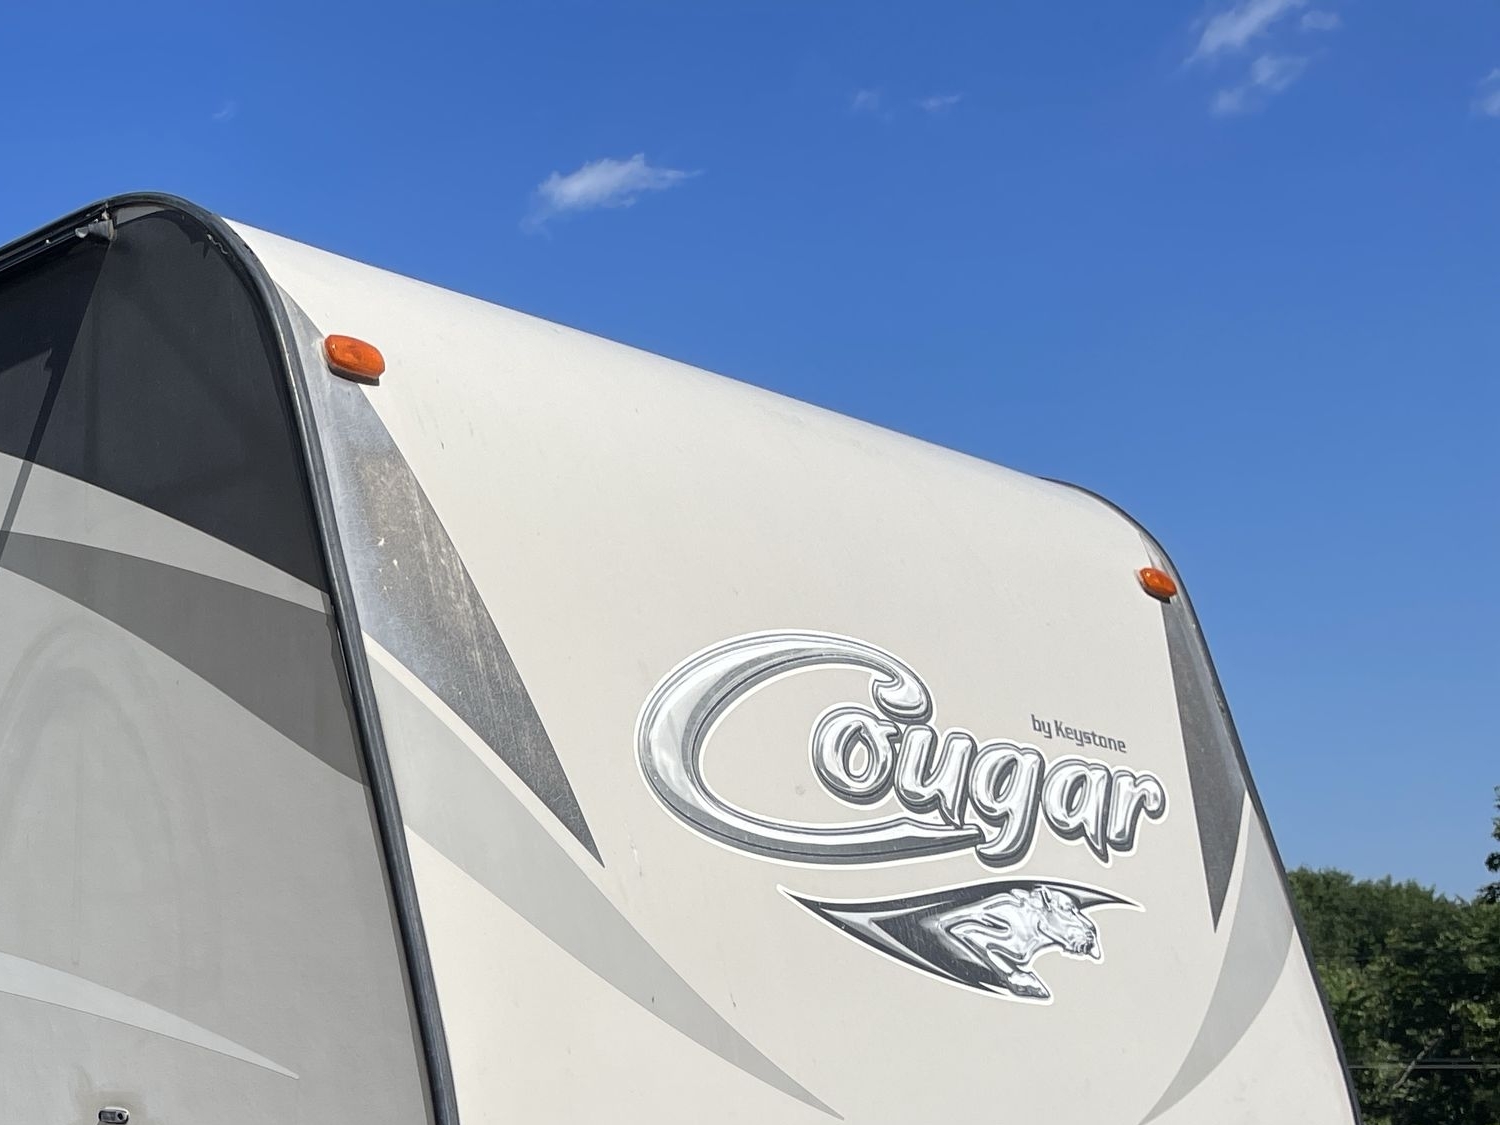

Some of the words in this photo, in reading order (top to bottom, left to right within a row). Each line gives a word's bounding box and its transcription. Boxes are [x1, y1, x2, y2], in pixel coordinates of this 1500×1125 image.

[636, 630, 1167, 869] Cougar
[1030, 713, 1052, 739] by
[1053, 719, 1127, 753] Keystone
